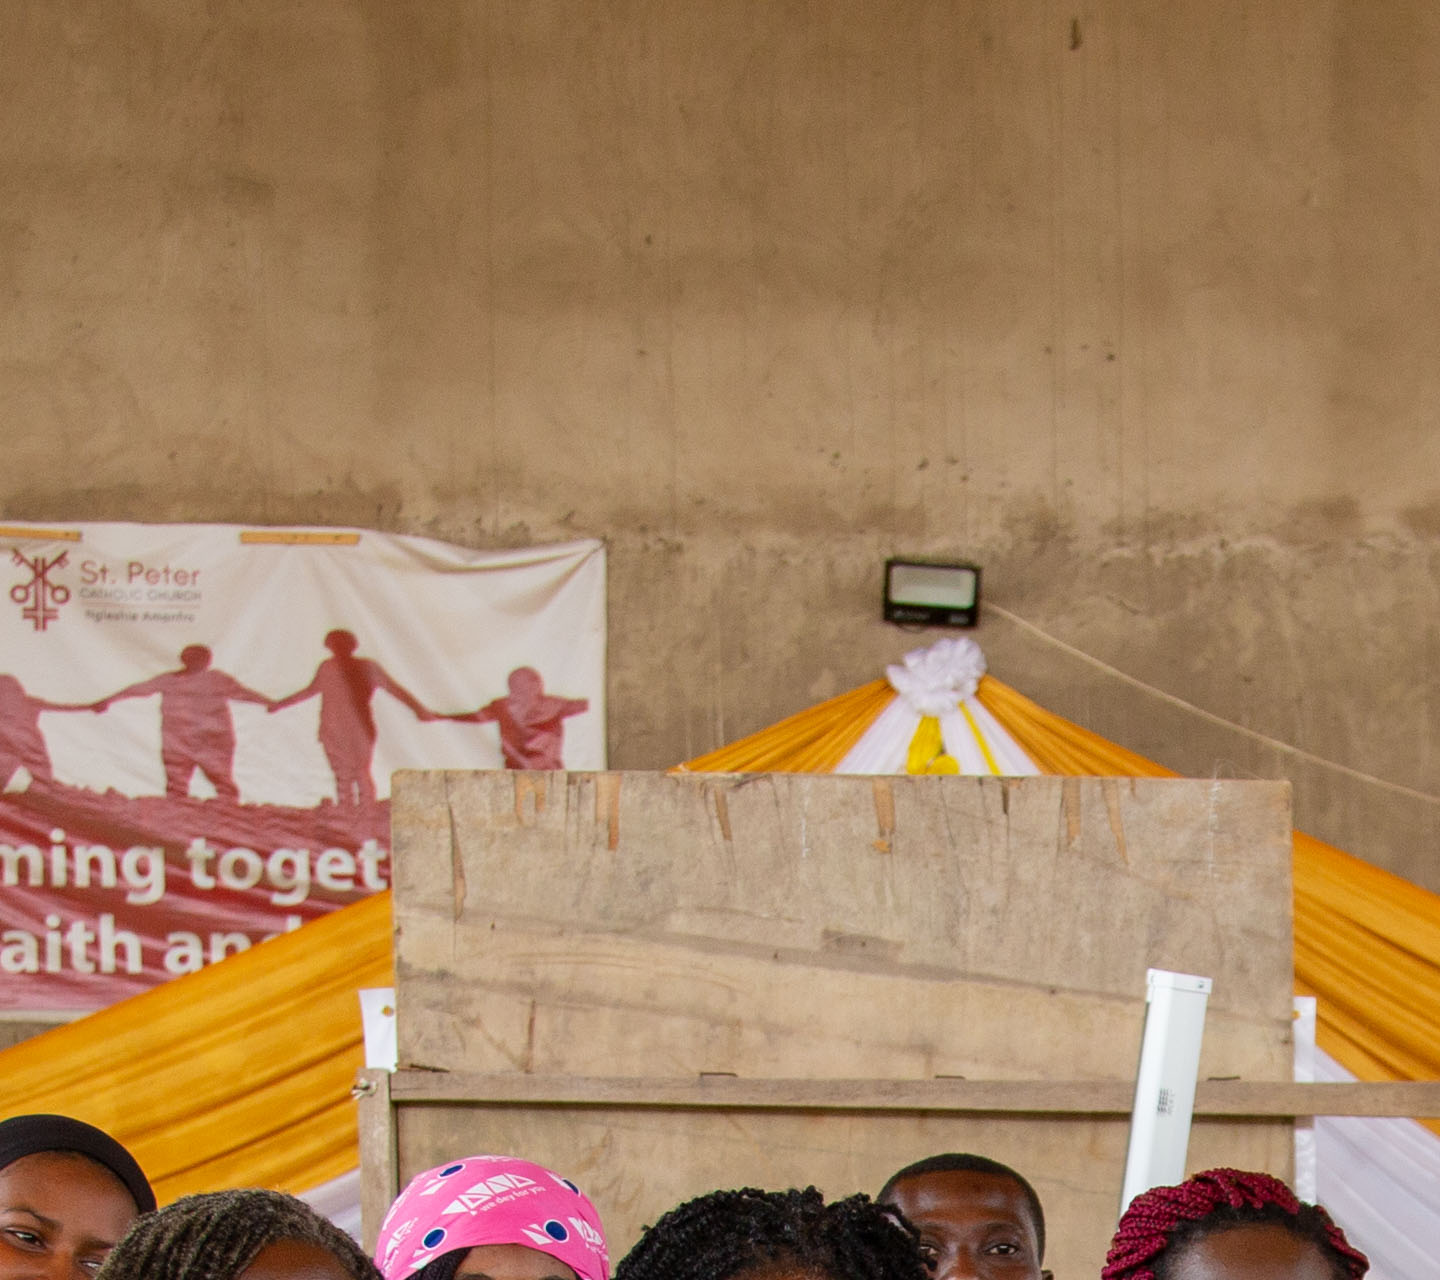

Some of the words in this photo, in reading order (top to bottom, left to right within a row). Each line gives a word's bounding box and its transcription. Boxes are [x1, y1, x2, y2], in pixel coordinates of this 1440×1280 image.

[81, 560, 116, 585] St.
[128, 561, 200, 586] Peter
[79, 587, 143, 599] CATHOLIC
[186, 837, 388, 906] toget
